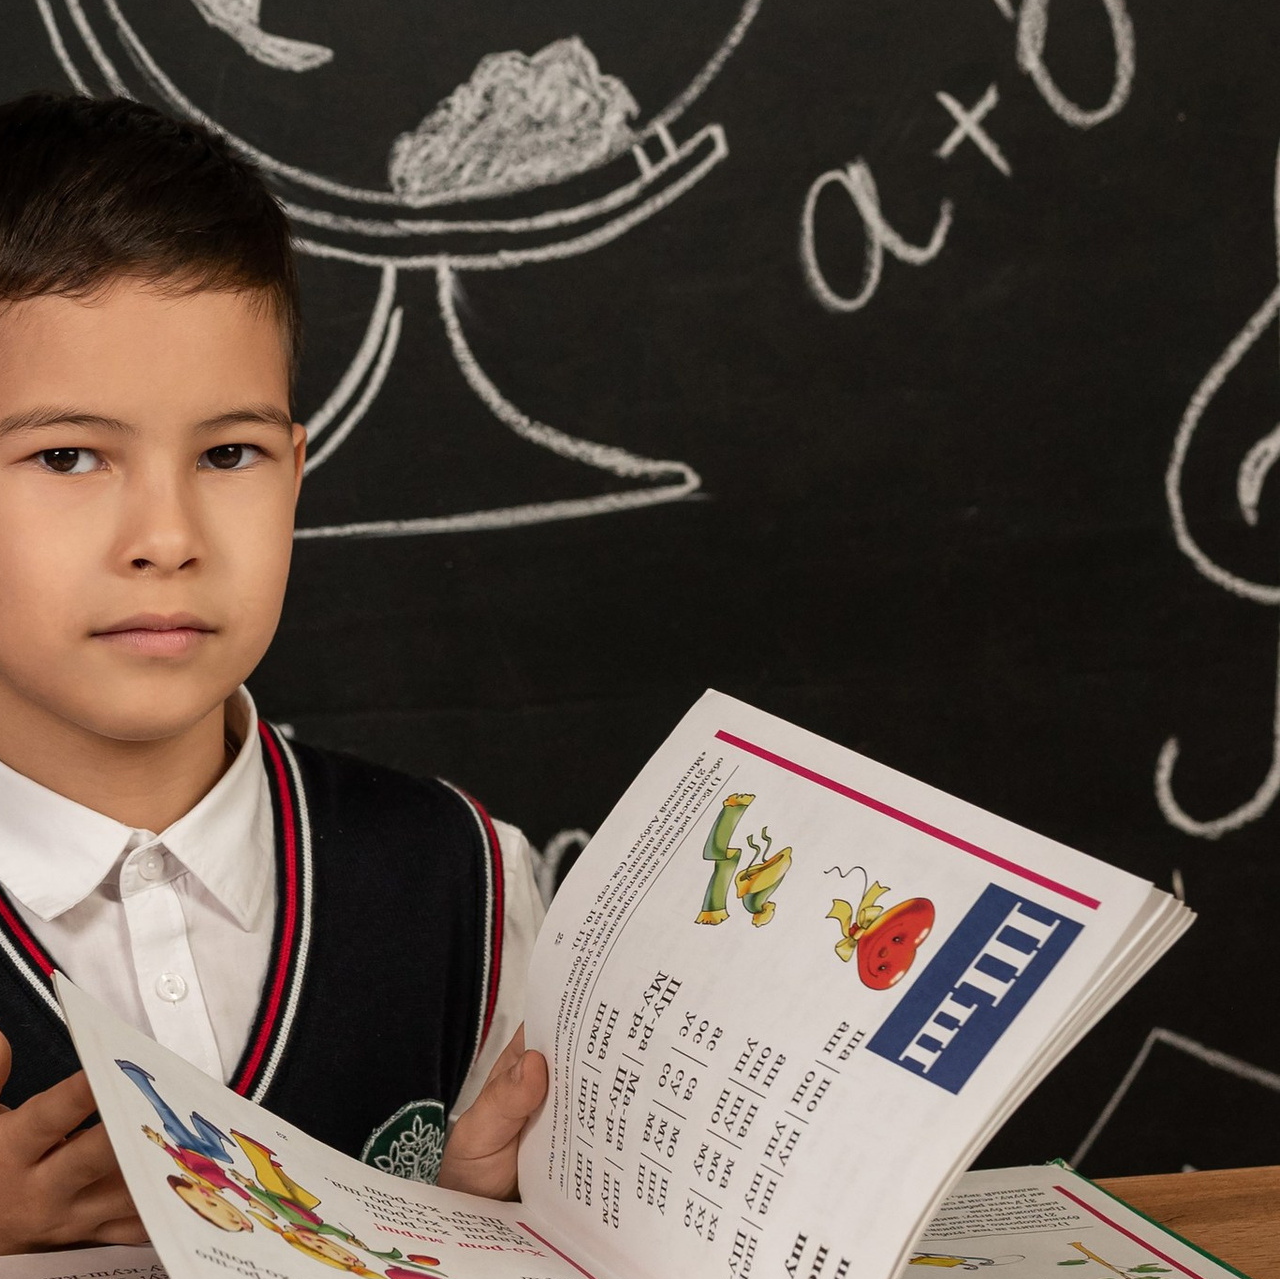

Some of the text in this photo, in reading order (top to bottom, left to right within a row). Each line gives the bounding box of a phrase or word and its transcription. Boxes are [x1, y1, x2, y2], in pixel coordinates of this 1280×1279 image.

[898, 902, 1060, 1073] Шш
[823, 1021, 850, 1054] аш
[837, 1030, 865, 1061] ша
[573, 1001, 608, 1201] шмо шру шро
[582, 1008, 620, 1207] шма шму шра
[600, 969, 669, 1226] Му-ра Шу-ра шум
[606, 976, 683, 1230] Шу-ра Ма-ша шар
[635, 1011, 697, 1199] ус со ма шо
[791, 1070, 816, 1104] ош
[806, 1078, 831, 1113] шо
[646, 1019, 709, 1206] ос су му ша
[656, 1026, 723, 1216] ас са мо шу
[683, 1037, 759, 1228] уш шо му хо
[693, 1046, 772, 1237] ош шу мо ху
[706, 1053, 787, 1242] аш ша ма ха
[763, 1120, 786, 1158] уш
[777, 1130, 801, 1167] шу
[364, 1185, 504, 1228] Шар хо-рош
[743, 1171, 764, 1210] шу
[758, 1180, 777, 1215] ша
[356, 1198, 524, 1241] Са-ша хо-рош.
[364, 1208, 533, 1248] Марш хо-рош.
[373, 1222, 546, 1258] Хо-рош марш!
[438, 1215, 513, 1233] Ма-ша
[784, 1233, 808, 1279] шу
